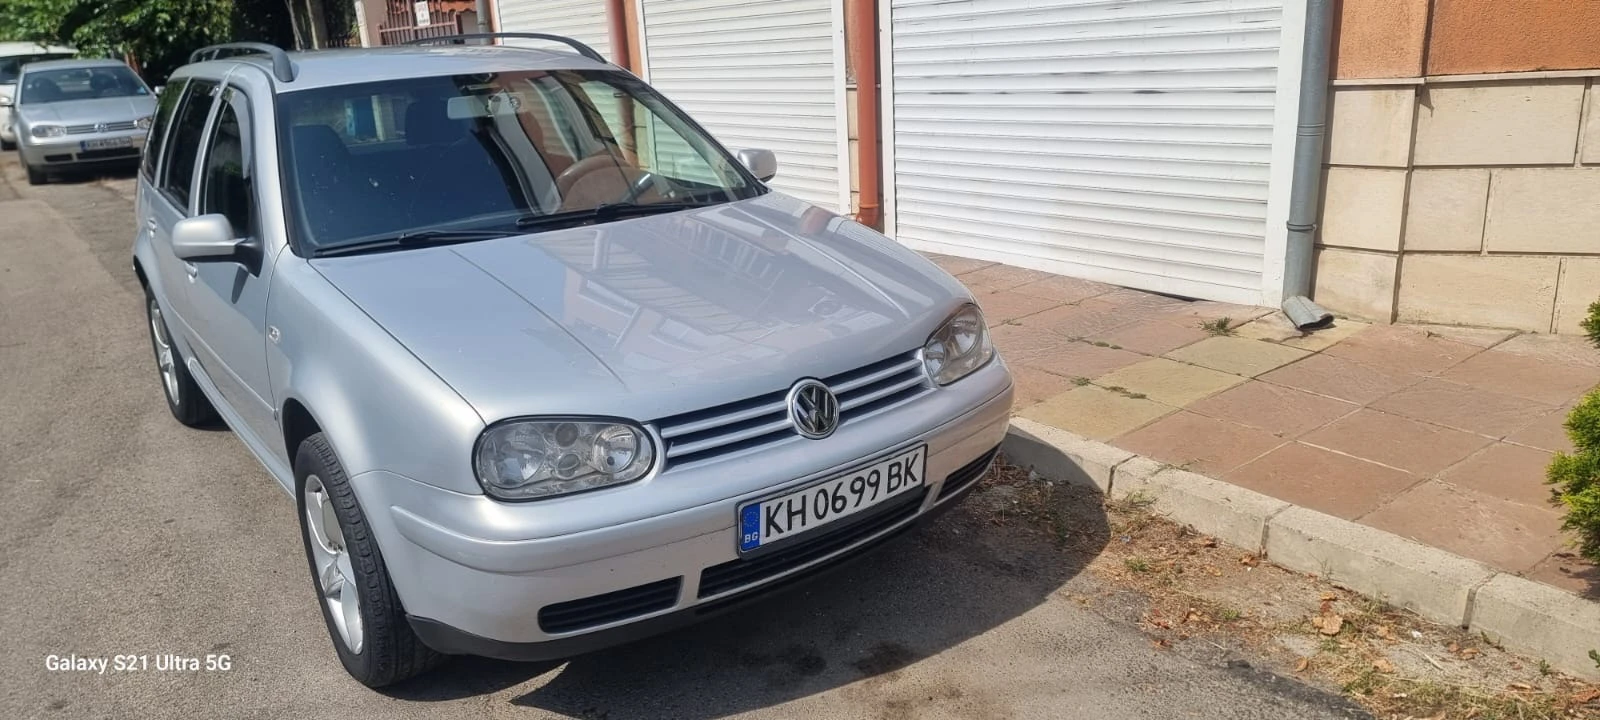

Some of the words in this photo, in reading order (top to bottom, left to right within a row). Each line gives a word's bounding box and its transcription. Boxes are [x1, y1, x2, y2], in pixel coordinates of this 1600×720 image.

[765, 495, 806, 537] KH
[814, 469, 881, 521] 0699
[887, 452, 920, 494] BK
[744, 531, 759, 544] BG
